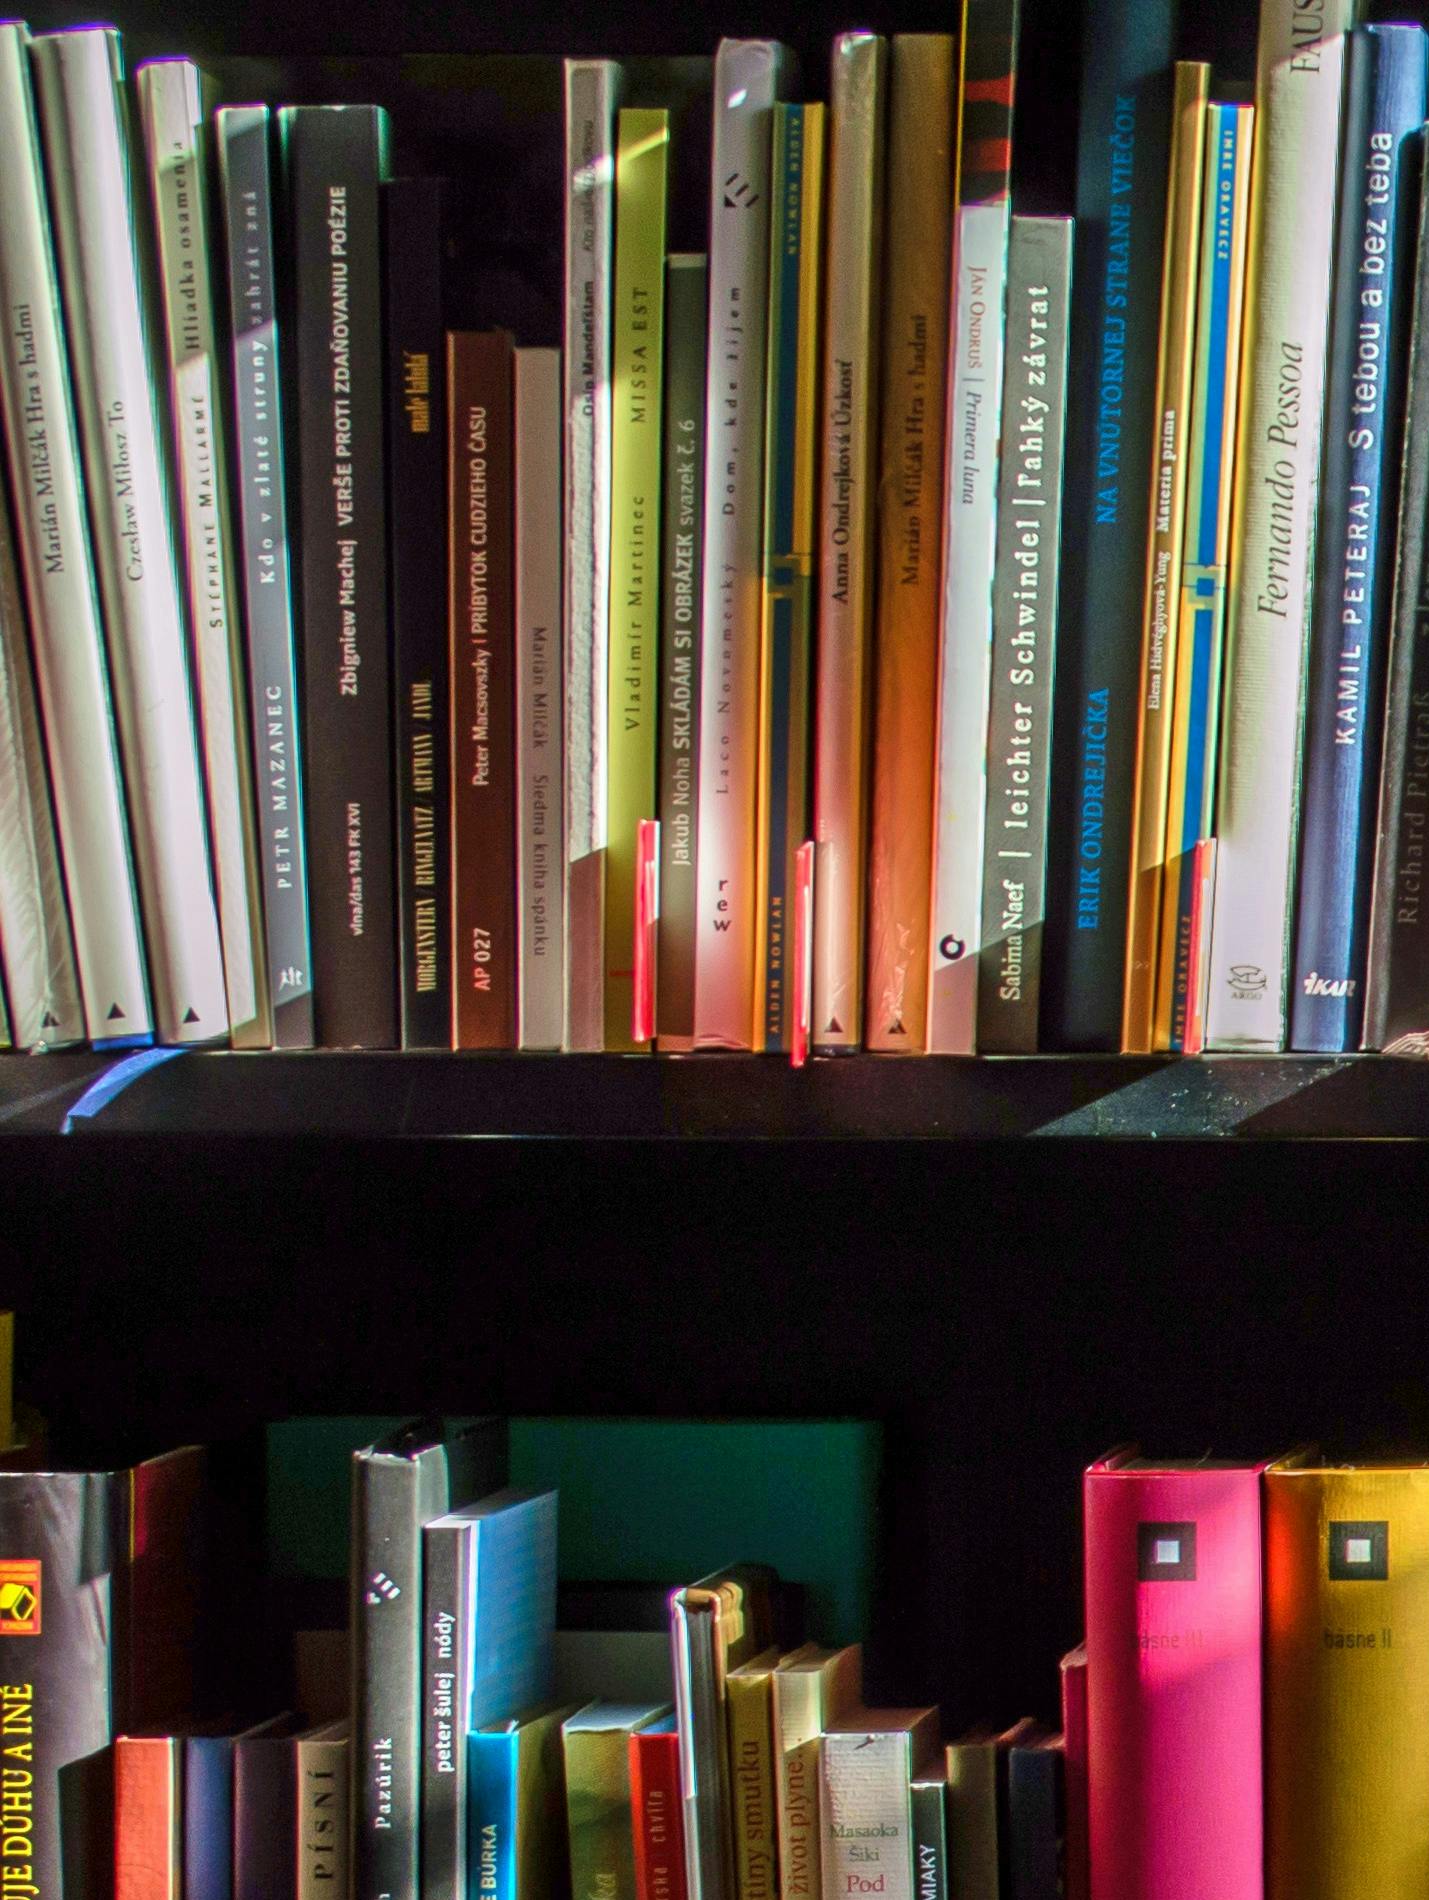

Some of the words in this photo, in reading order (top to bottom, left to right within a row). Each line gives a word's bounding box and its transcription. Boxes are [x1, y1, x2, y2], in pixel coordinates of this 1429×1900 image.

[1364, 131, 1394, 205] teba
[326, 184, 349, 255] POÉZIE
[1358, 218, 1387, 273] bez
[327, 260, 353, 393] ZDAŇOVANIU
[1359, 287, 1383, 306] a
[1266, 340, 1304, 446] Pessoa
[1351, 320, 1385, 416] tebou
[332, 398, 353, 456] PROTI
[1348, 427, 1375, 449] S
[331, 461, 356, 525] VERŠE
[336, 539, 361, 605] Machej
[1256, 458, 1299, 618] Fernando
[1339, 482, 1372, 625] PETERAJ
[336, 611, 362, 695] Zbigniew
[1333, 640, 1363, 744] KAMIL
